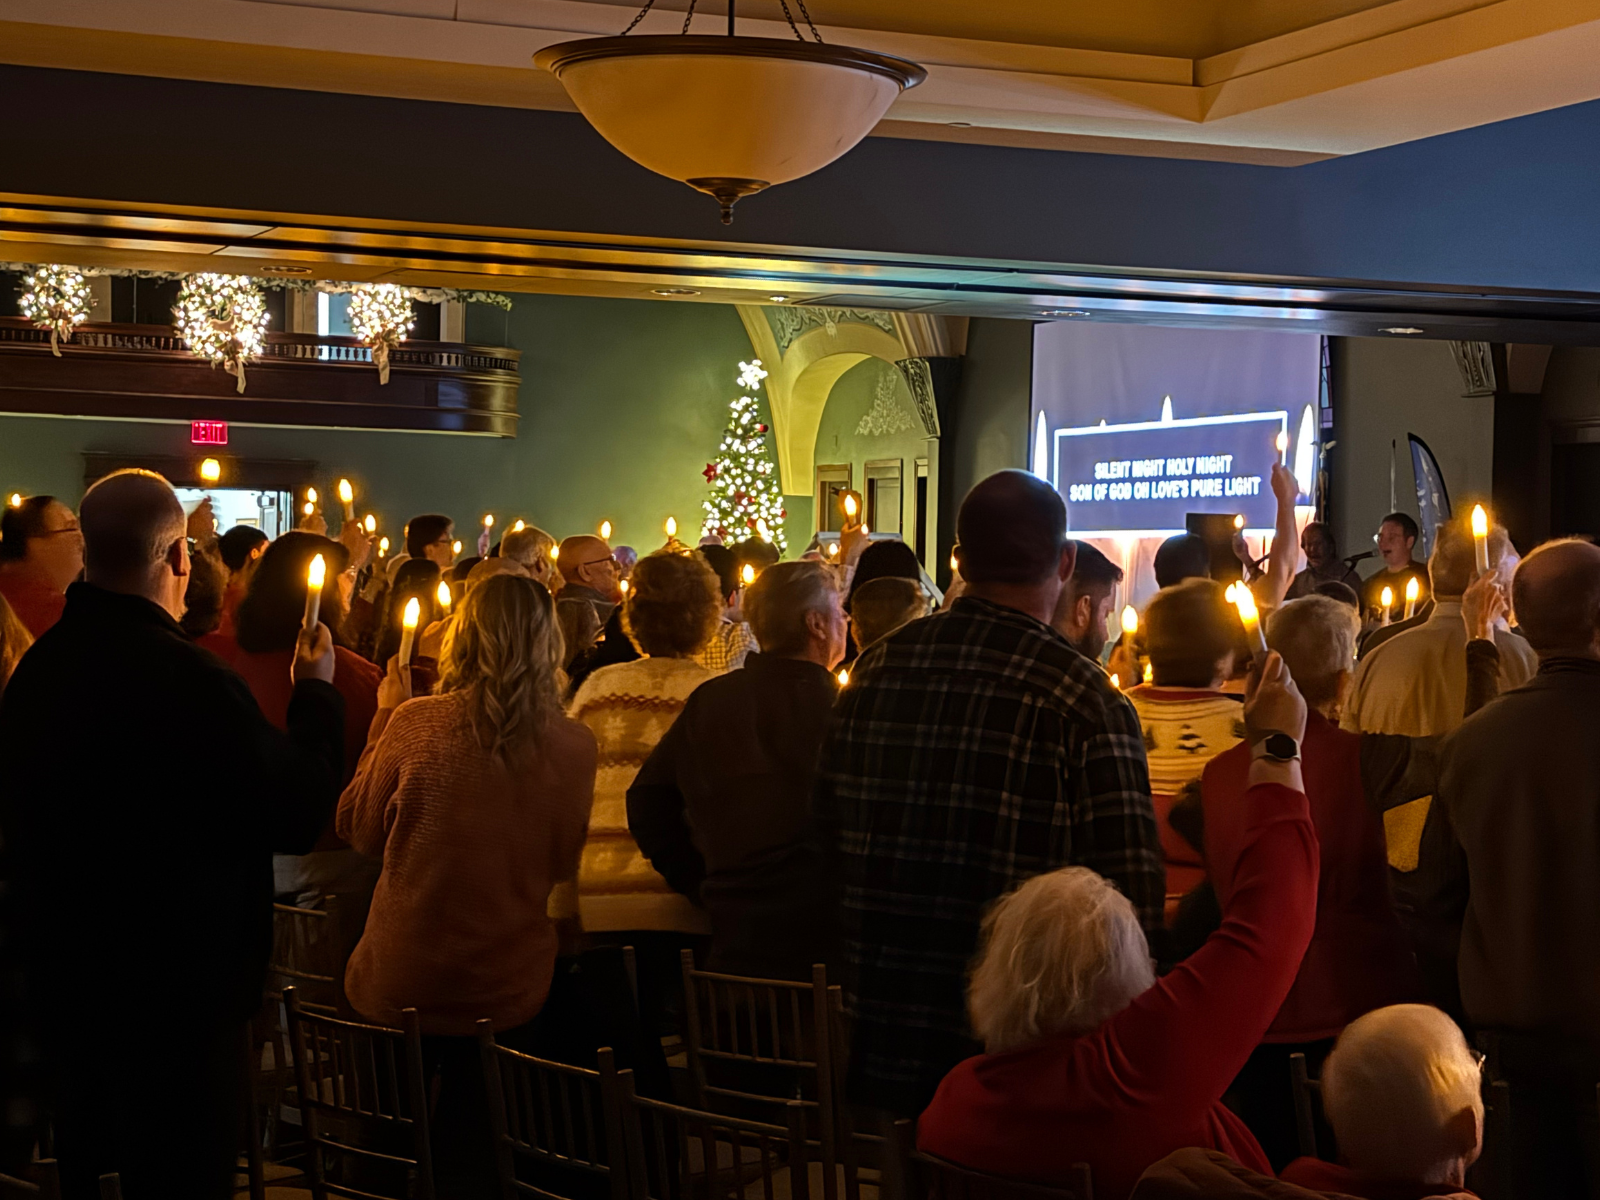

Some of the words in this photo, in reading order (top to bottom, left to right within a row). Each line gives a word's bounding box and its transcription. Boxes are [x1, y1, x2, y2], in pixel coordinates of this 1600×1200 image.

[199, 422, 223, 441] EXIT
[1095, 461, 1131, 480] SILENT
[1132, 459, 1165, 477] NIGHT
[1166, 457, 1195, 476] HOLY
[1196, 455, 1233, 475] NIGHT
[1070, 484, 1093, 502] SON
[1094, 483, 1108, 500] OF
[1109, 482, 1132, 500] GOD
[1151, 479, 1190, 499] LOVE'S
[1191, 478, 1223, 497] PURE
[1224, 476, 1261, 496] LIGHT
